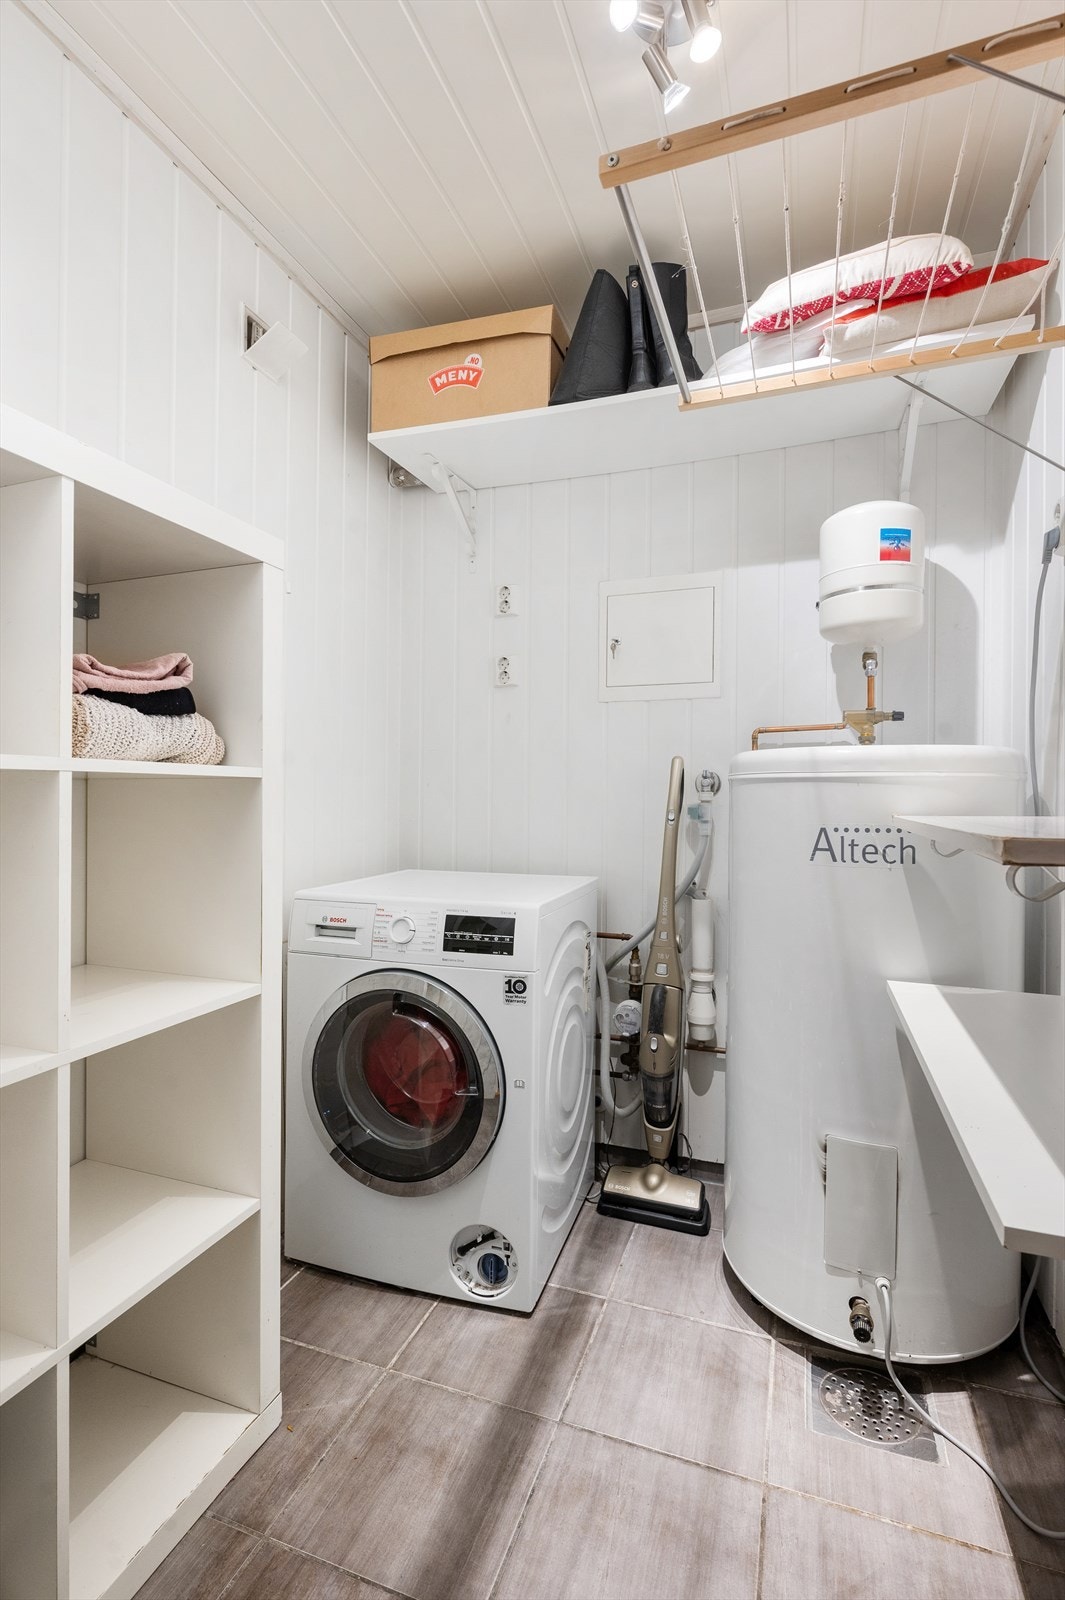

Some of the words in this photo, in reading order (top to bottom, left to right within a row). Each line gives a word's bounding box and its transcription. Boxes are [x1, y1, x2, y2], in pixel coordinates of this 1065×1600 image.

[434, 370, 478, 387] MENY
[810, 827, 916, 864] Altech
[504, 978, 527, 994] 10
